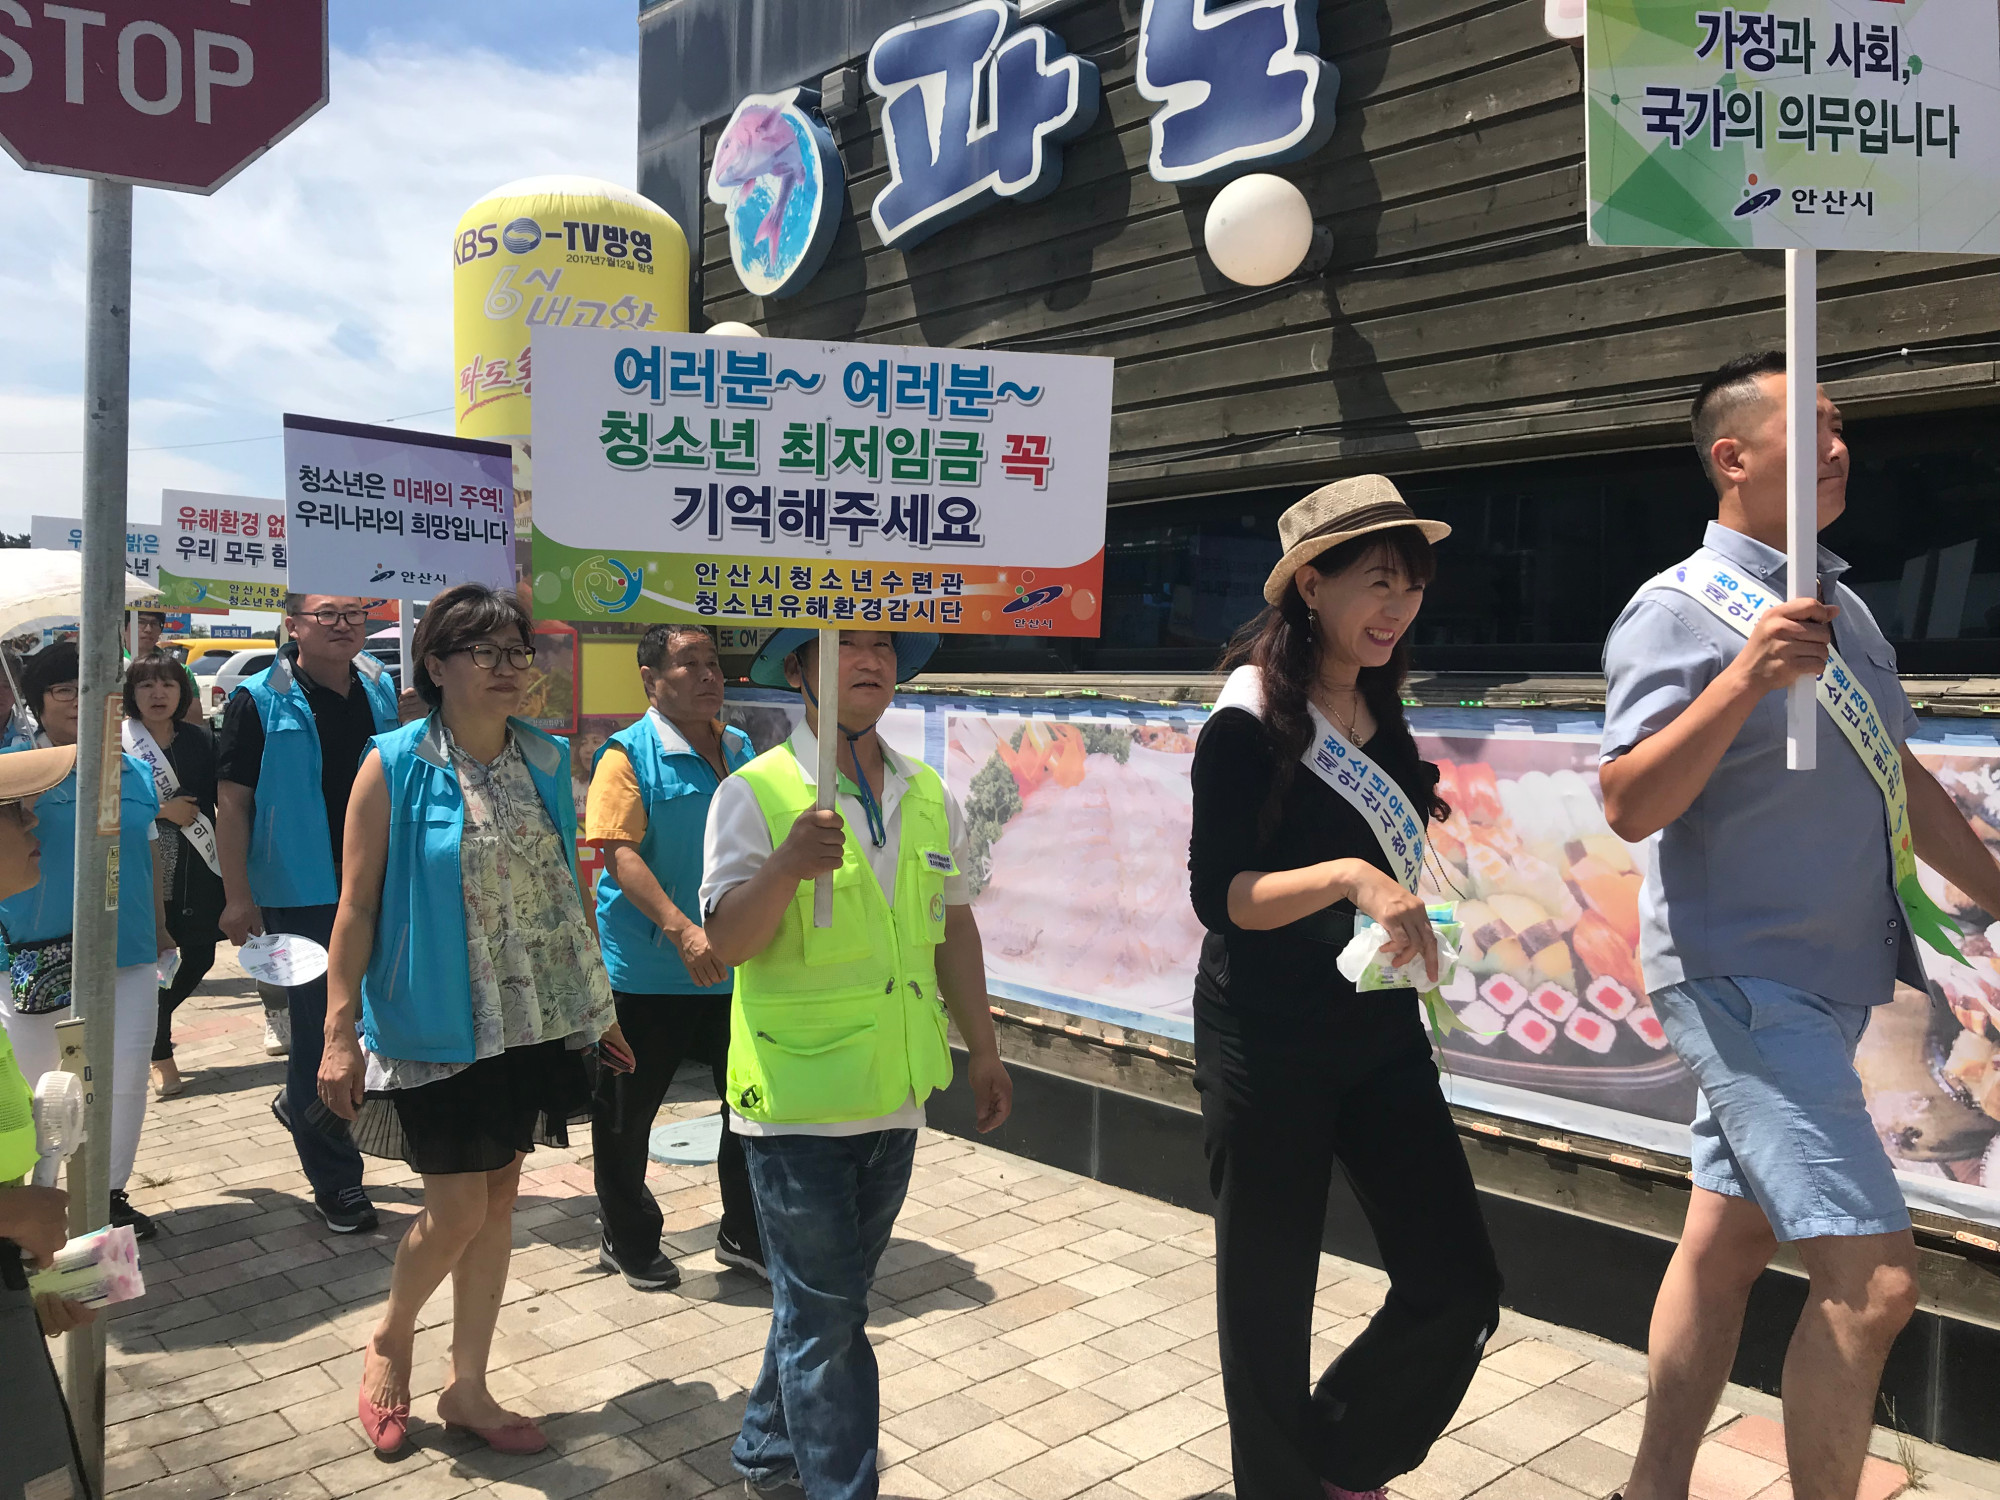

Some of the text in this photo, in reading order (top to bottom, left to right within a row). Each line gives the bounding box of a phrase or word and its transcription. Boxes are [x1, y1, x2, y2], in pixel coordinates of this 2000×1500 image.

[0, 2, 254, 125] STOP
[1697, 10, 1911, 86] 가정과 사회,
[1642, 85, 1960, 159] 국가의 의무입니다
[1791, 188, 1874, 216] 안산시
[453, 223, 498, 270] KBS
[566, 254, 654, 275] 2017년7월12일 방영
[613, 346, 1041, 416] 여러분~ 여러분~
[599, 410, 1051, 487] 청소년 최저임금 꼭
[299, 464, 504, 514] 청소년은 미래의 주역!
[177, 506, 260, 537] 유해환경
[295, 500, 508, 546] 우리나라의 희망입니다
[671, 483, 982, 545] 기억해주세요
[176, 536, 217, 563] 우리
[223, 541, 265, 568] 모두
[401, 571, 447, 585] 안산시
[695, 589, 963, 624] 청소년유해환경감시단
[1014, 617, 1053, 630] 안산시
[720, 629, 758, 648] SECOM
